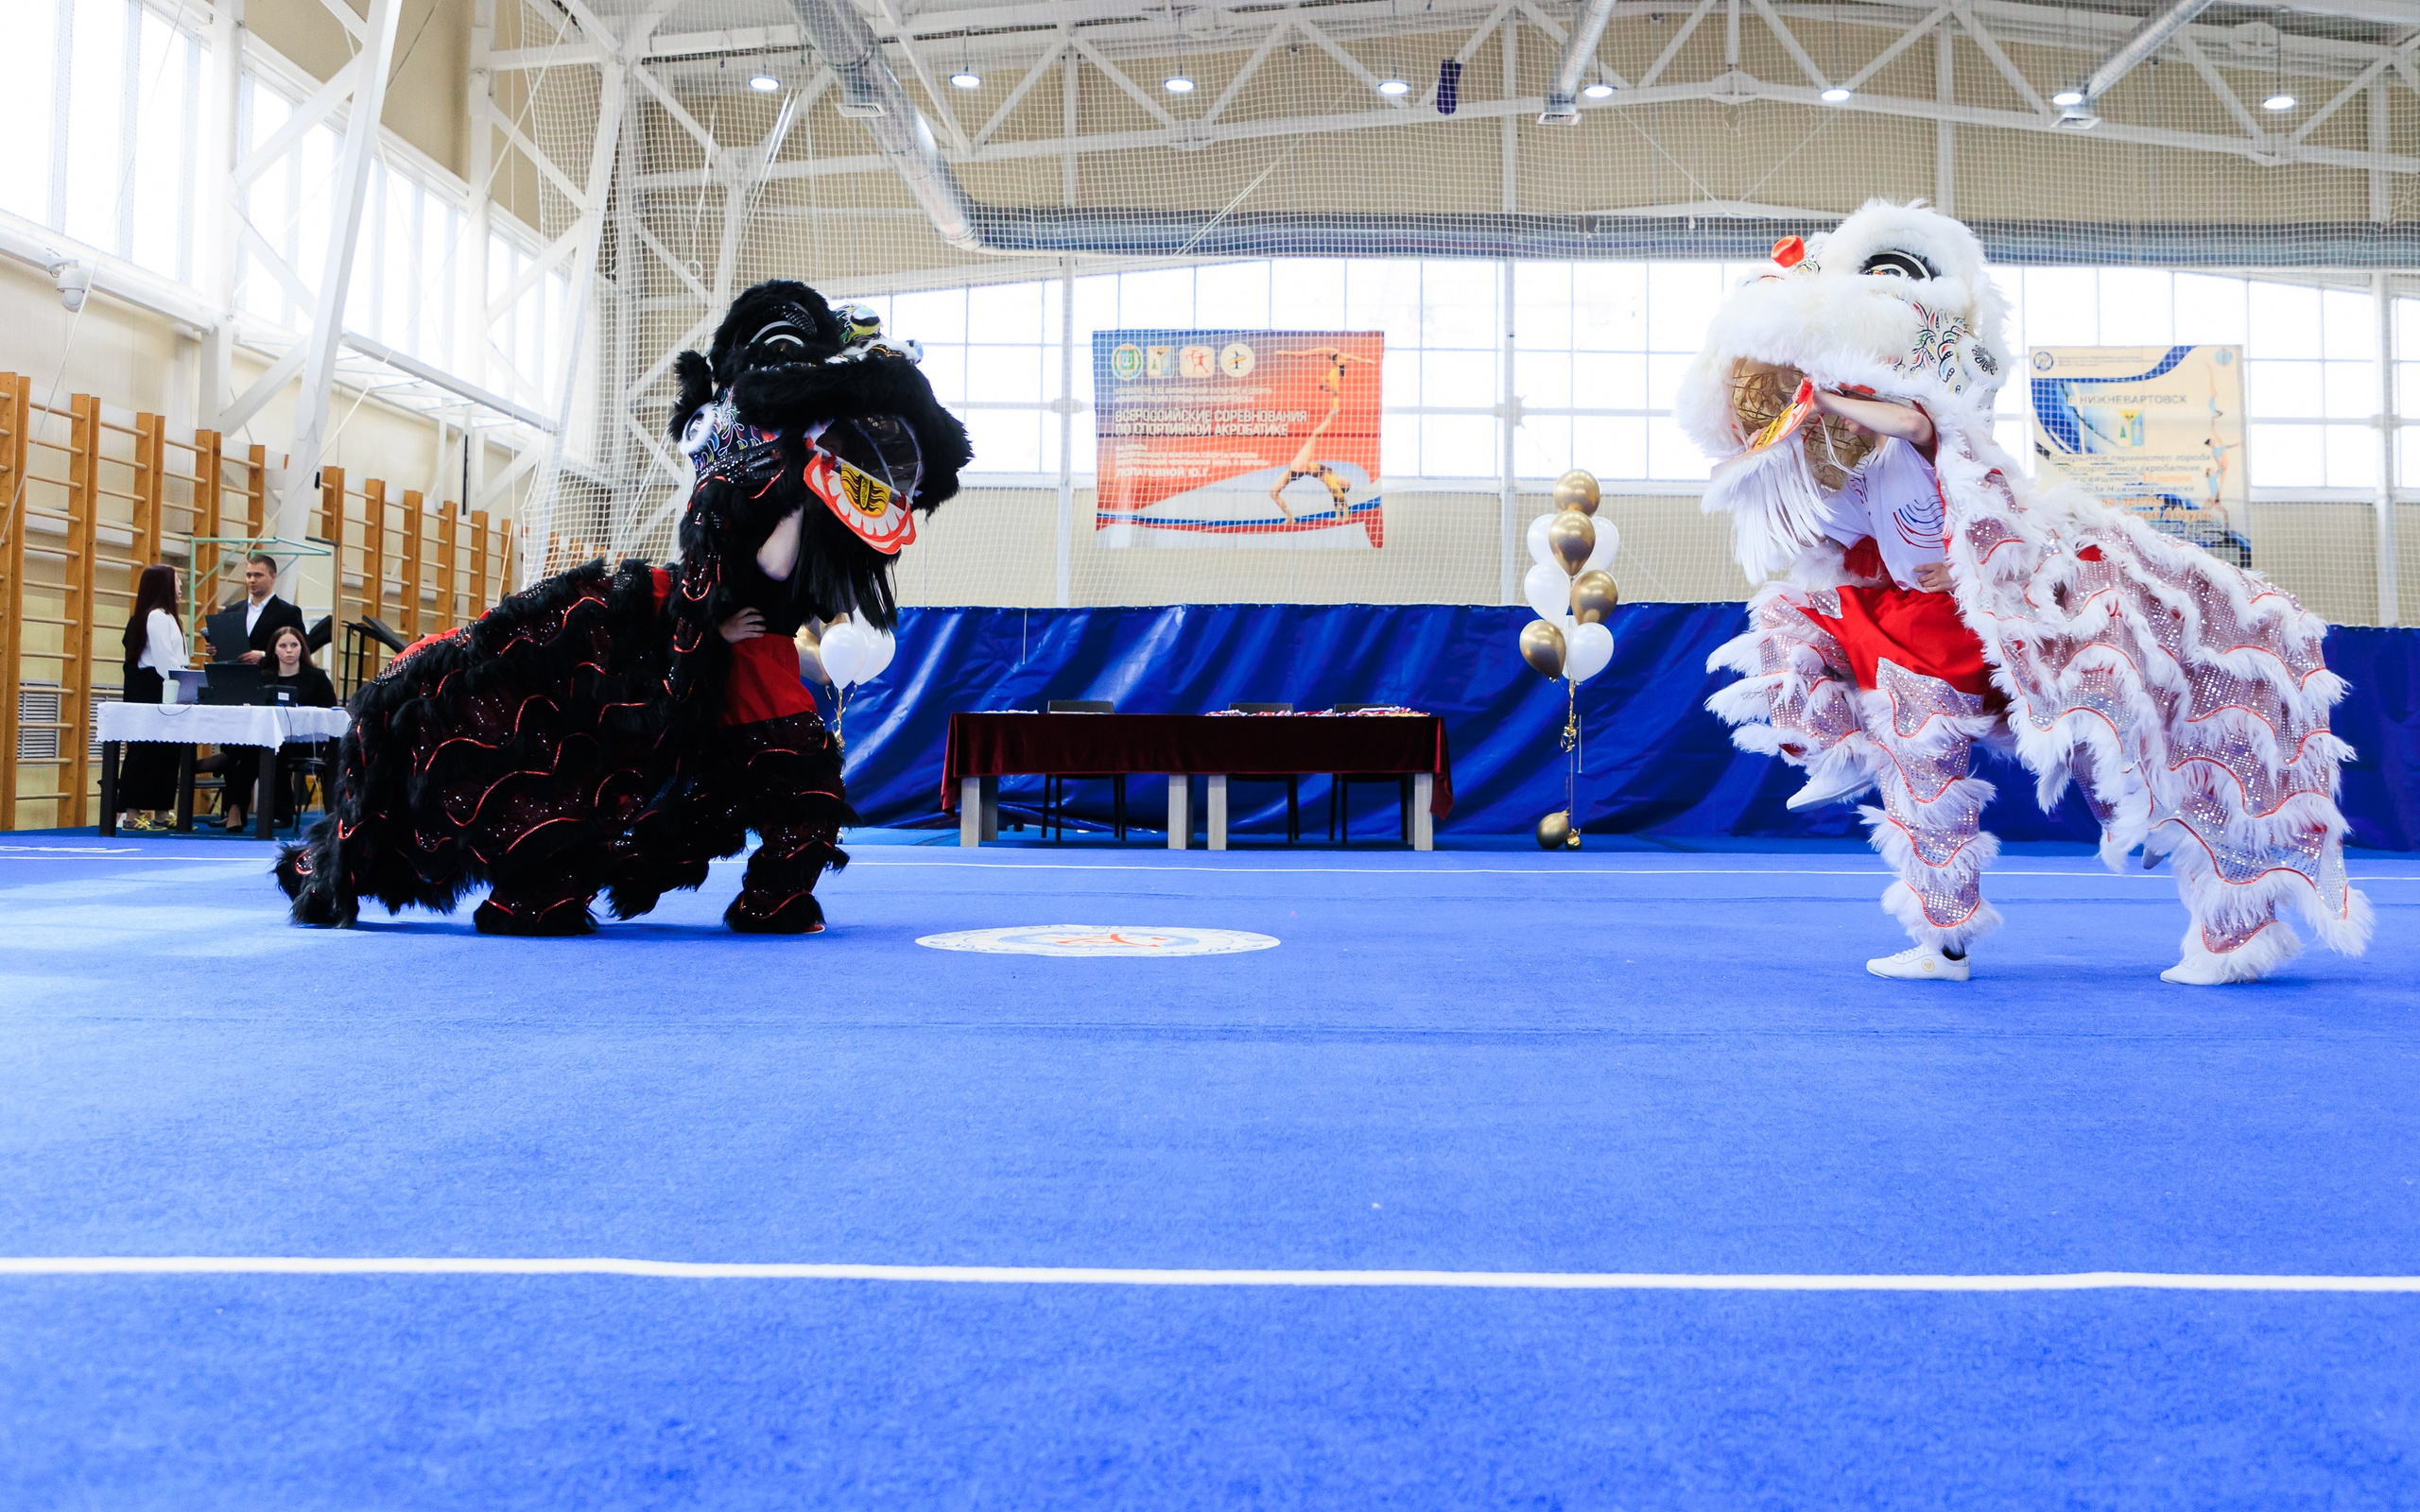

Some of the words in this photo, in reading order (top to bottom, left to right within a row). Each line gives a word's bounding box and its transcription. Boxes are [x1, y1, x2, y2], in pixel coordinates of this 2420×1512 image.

[2079, 394, 2187, 404] НИЖНЕВАРТОВСК
[1115, 408, 1211, 424] ВСЕРОССИЙСКИЕ
[1214, 410, 1307, 423] СОРЕВНОВАНИЯ
[1115, 424, 1131, 437] ПО
[1133, 423, 1212, 437] СПОРТИВНОЙ
[1214, 424, 1288, 437] АКРОБАТИКЕ
[2050, 454, 2107, 463] Открытое
[2175, 454, 2210, 462] города
[1116, 467, 1185, 477] ЛОПАТКИНОЙ
